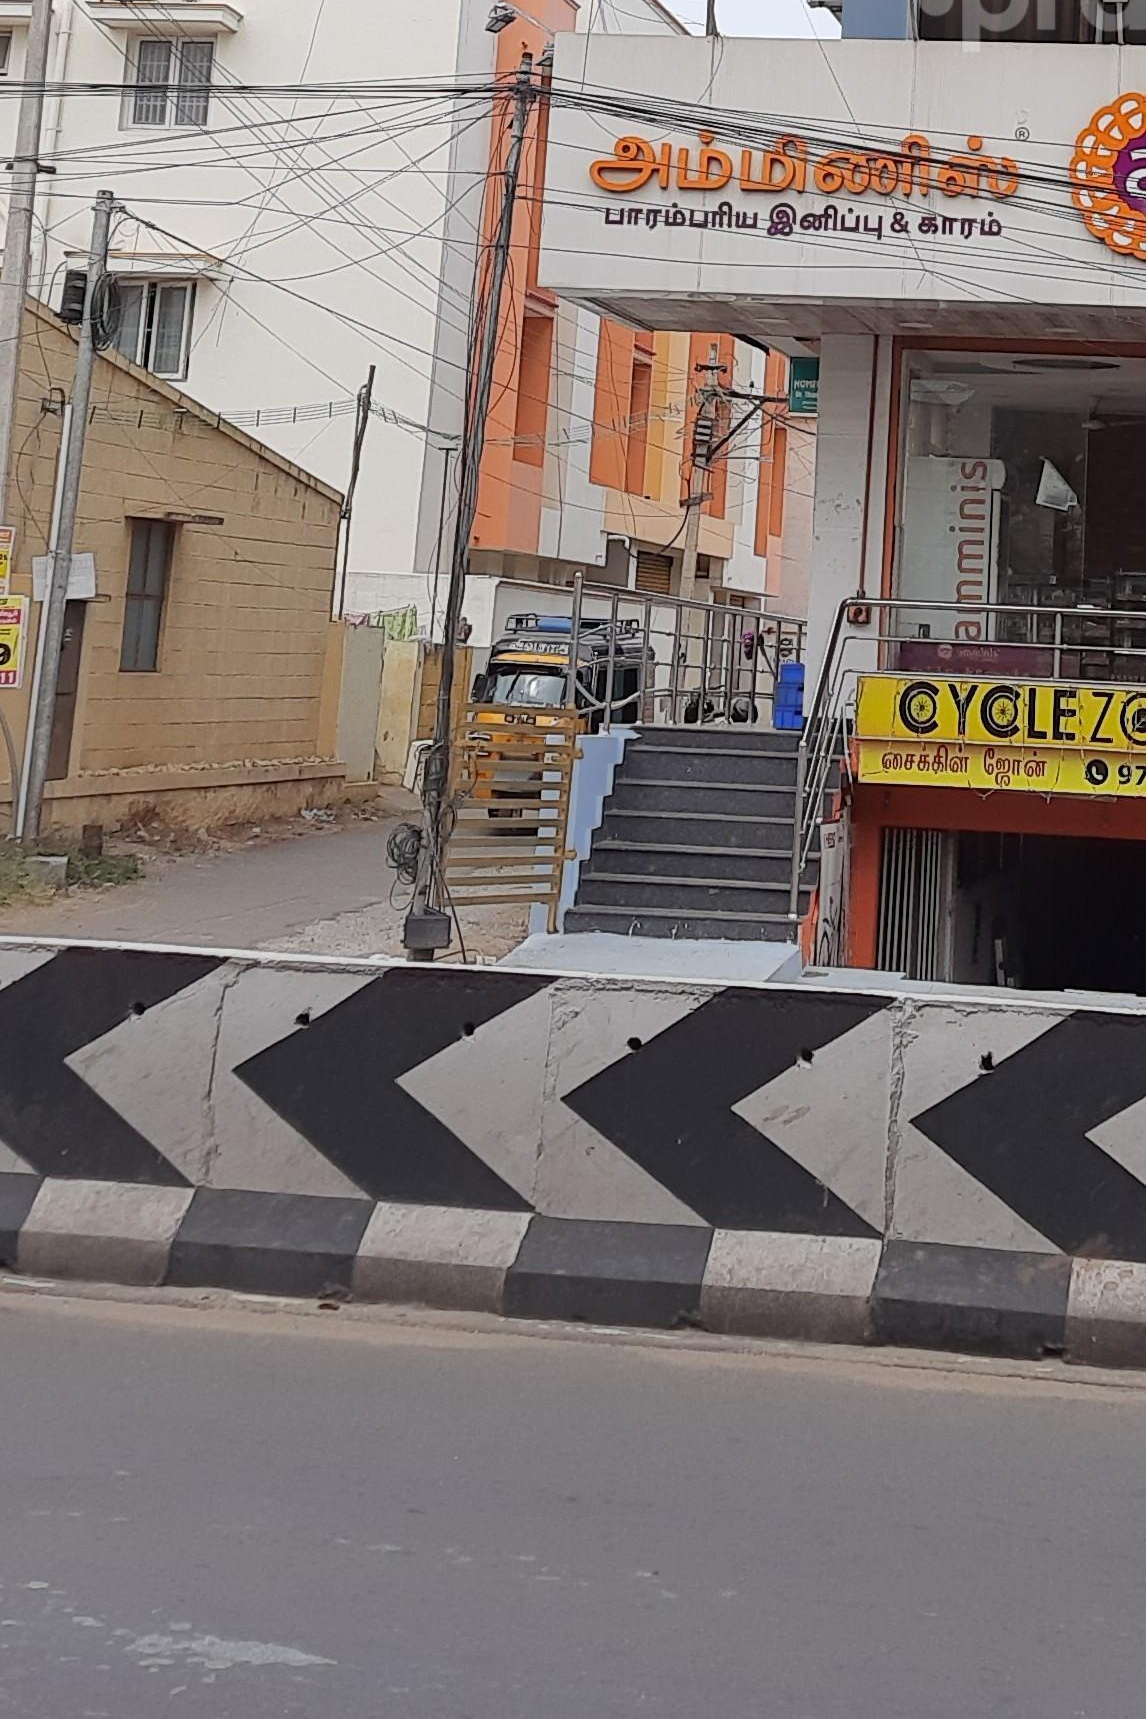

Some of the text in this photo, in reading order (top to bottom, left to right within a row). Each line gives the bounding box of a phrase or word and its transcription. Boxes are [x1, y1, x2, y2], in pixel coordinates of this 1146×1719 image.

[604, 202, 1002, 240] பாரம்பரிய இனிப்பு & காரம்
[881, 744, 1048, 787] சைக்கிள் ஜோன்
